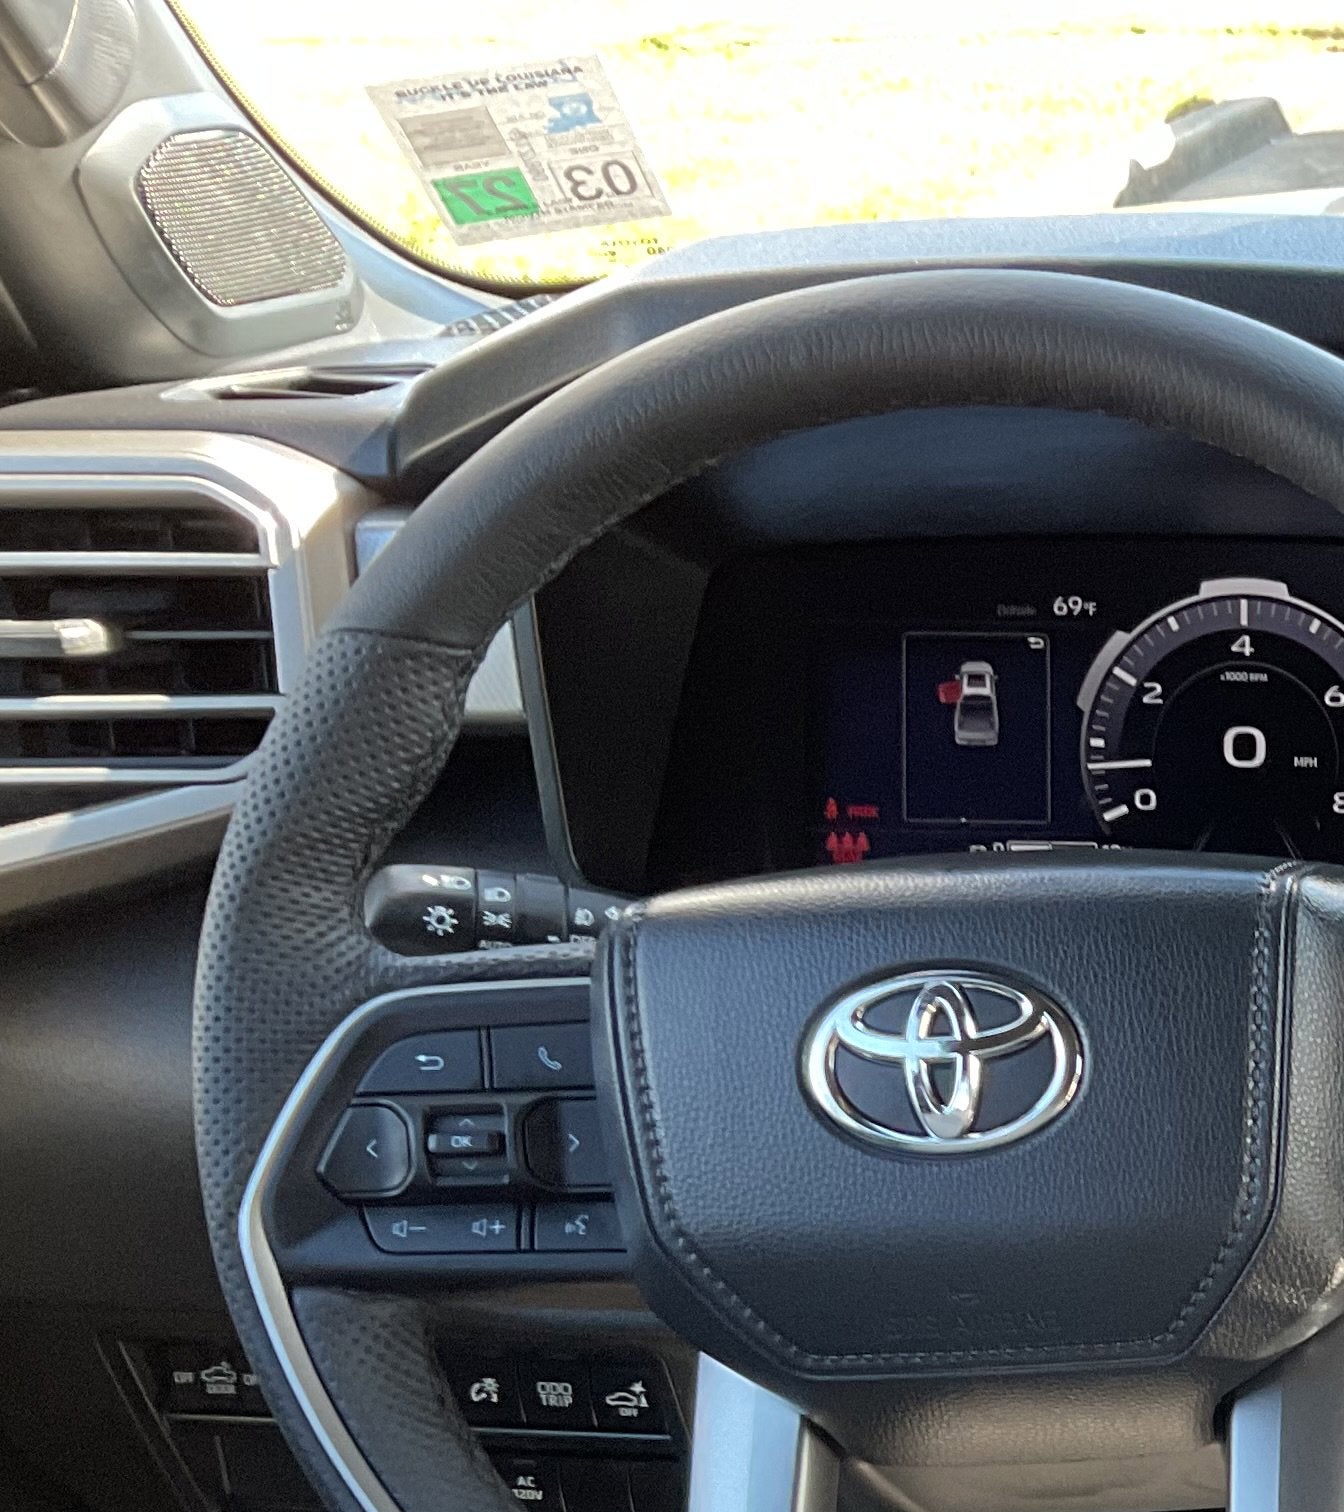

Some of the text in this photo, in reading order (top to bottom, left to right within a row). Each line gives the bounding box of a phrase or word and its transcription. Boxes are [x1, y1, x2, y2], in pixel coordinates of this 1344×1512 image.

[1230, 635, 1255, 656] 4
[1142, 681, 1164, 704] 2
[1223, 725, 1267, 769] 0
[1294, 756, 1318, 769] MPH
[1134, 788, 1157, 811] 0
[451, 1135, 473, 1148] OK
[539, 1394, 573, 1408] TRIP
[517, 1476, 536, 1488] AC
[512, 1488, 543, 1500] 120V
